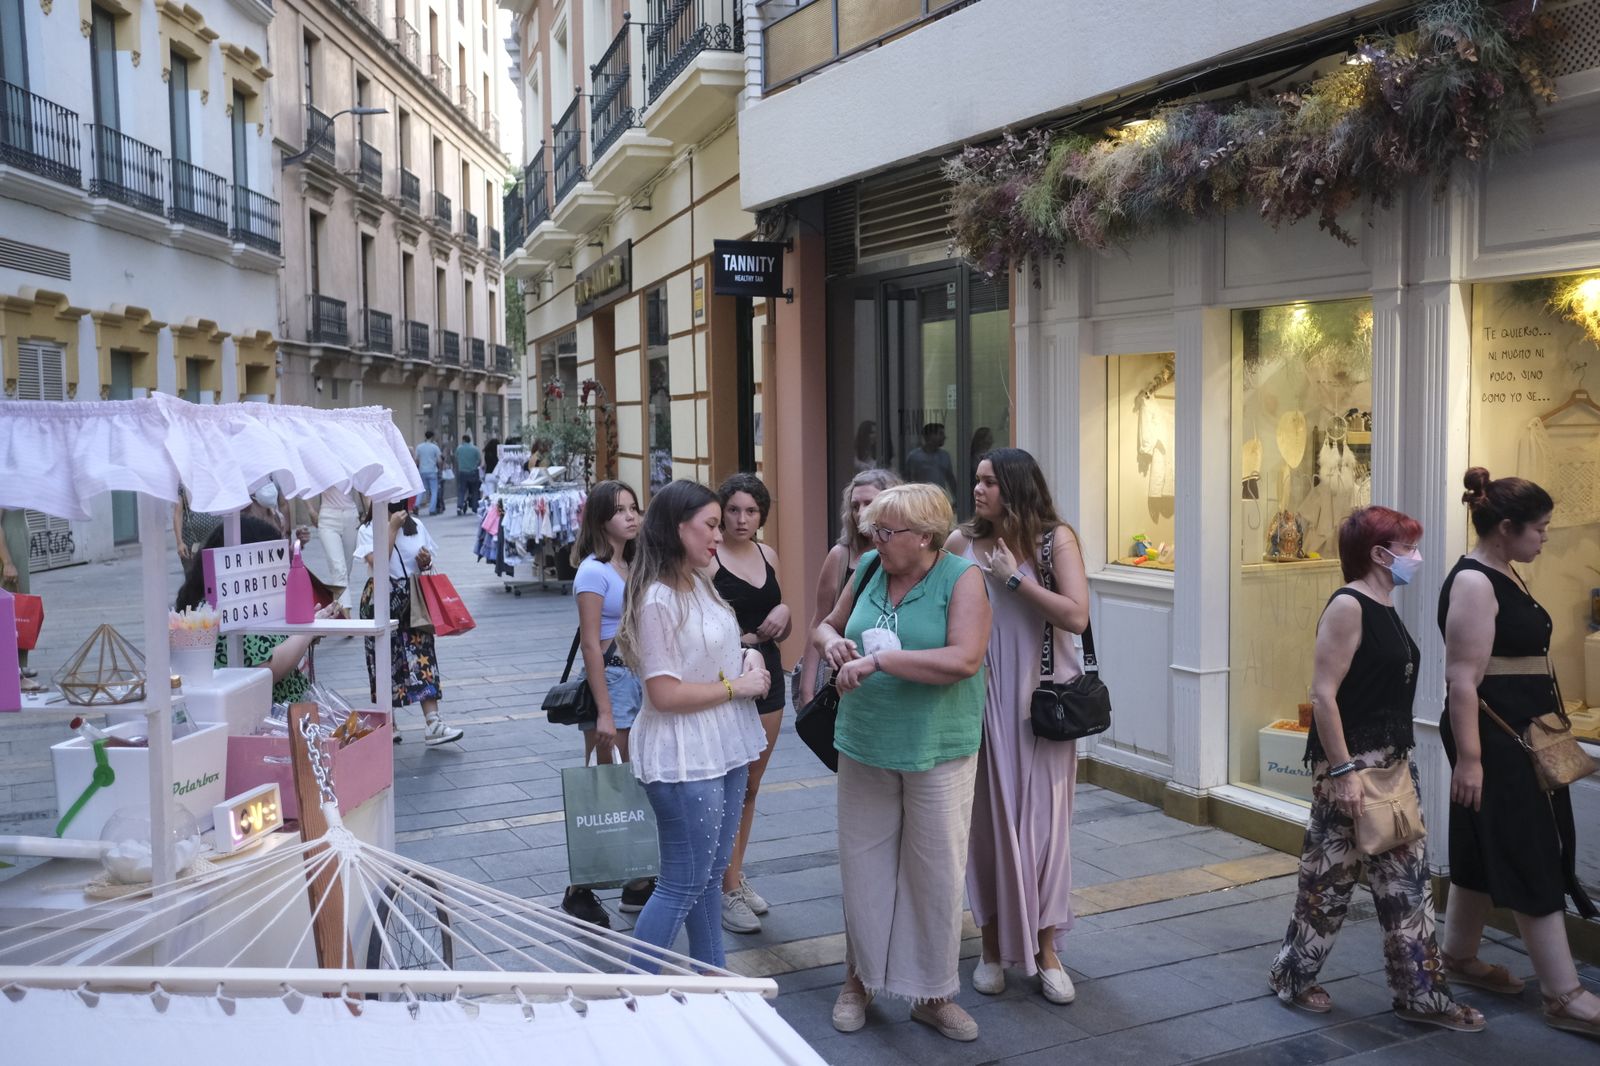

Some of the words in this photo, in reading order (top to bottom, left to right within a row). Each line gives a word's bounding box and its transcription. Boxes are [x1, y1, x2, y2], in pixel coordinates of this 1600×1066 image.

[722, 254, 775, 272] TANNITY
[1483, 327, 1497, 341] TE
[1488, 351, 1497, 361] NI
[1502, 349, 1531, 360] MUCHO
[1535, 348, 1545, 358] NI
[1521, 369, 1543, 381] SINO
[1481, 392, 1506, 403] COMO
[1510, 392, 1522, 402] YO
[221, 573, 287, 597] SORBTOS
[222, 602, 269, 624] ROSAS
[172, 772, 220, 796] Polarbox
[576, 809, 645, 828] PULL&BEAR
